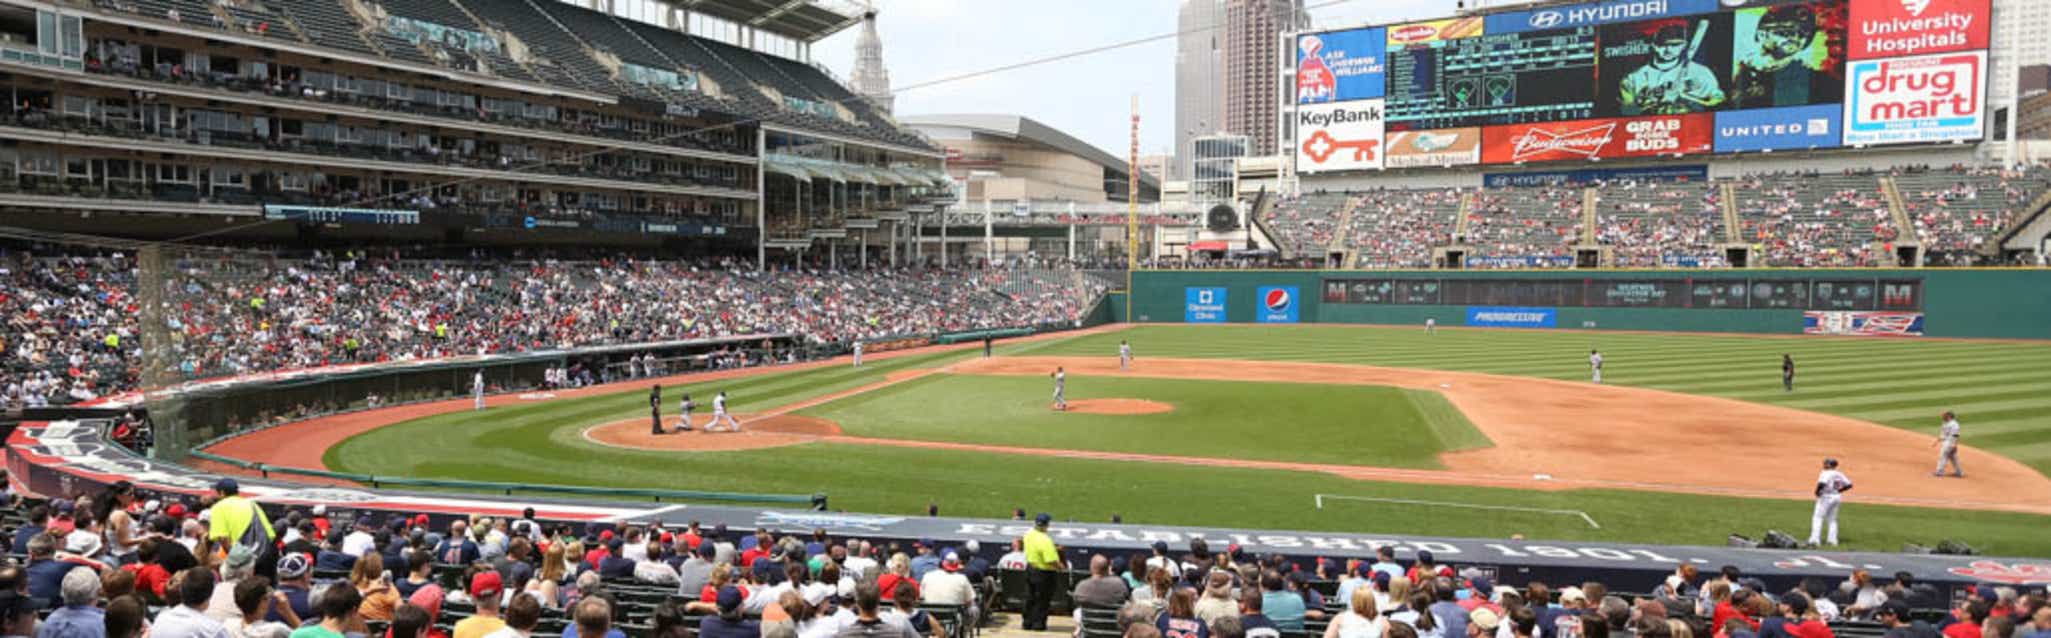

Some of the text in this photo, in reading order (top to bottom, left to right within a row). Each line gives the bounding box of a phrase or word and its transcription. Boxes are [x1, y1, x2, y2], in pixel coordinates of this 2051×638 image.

[1568, 1, 1667, 24] HYUNDAI
[1862, 11, 1972, 35] University
[1604, 40, 1650, 58] SWISHER
[1866, 30, 1967, 54] Hospitals
[1863, 61, 1956, 97] drug
[1870, 93, 1972, 120] mart
[1300, 107, 1381, 127] KeyBank
[1626, 119, 1682, 133] GRAB
[1721, 123, 1802, 137] UNITED
[1511, 133, 1613, 151] Budweiser
[1626, 137, 1680, 151] BUDS
